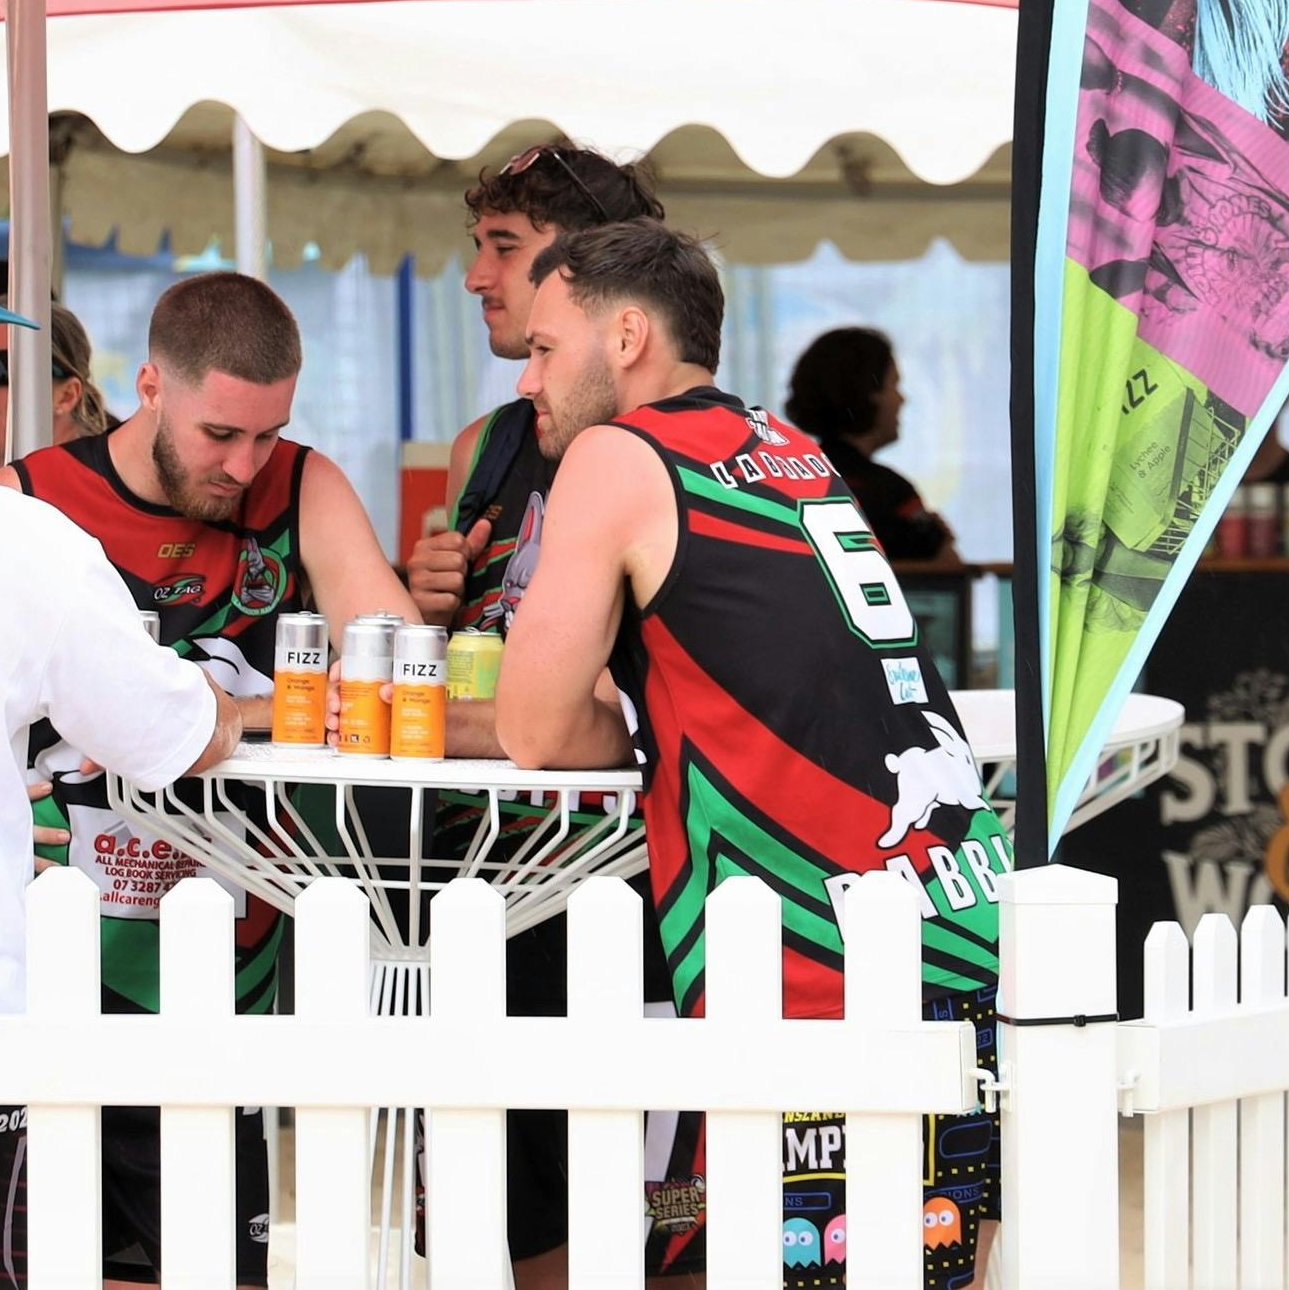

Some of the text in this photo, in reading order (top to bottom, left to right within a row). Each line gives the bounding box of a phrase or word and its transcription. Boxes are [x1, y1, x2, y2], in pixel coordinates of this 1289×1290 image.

[1130, 441, 1158, 470] Lychee
[1148, 445, 1171, 470] Apple
[798, 497, 917, 648] 6
[154, 585, 201, 600] OZ TAG
[287, 652, 321, 665] FIZZ
[403, 663, 437, 677] FIZZ
[95, 855, 112, 866] ALL
[115, 857, 175, 870] MECHANICAL
[105, 867, 197, 880] LOG BOOK SERVICING
[113, 879, 128, 891] 07
[131, 880, 161, 893] 3287
[652, 1187, 700, 1208] SUPER
[656, 1203, 698, 1219] SERIES
